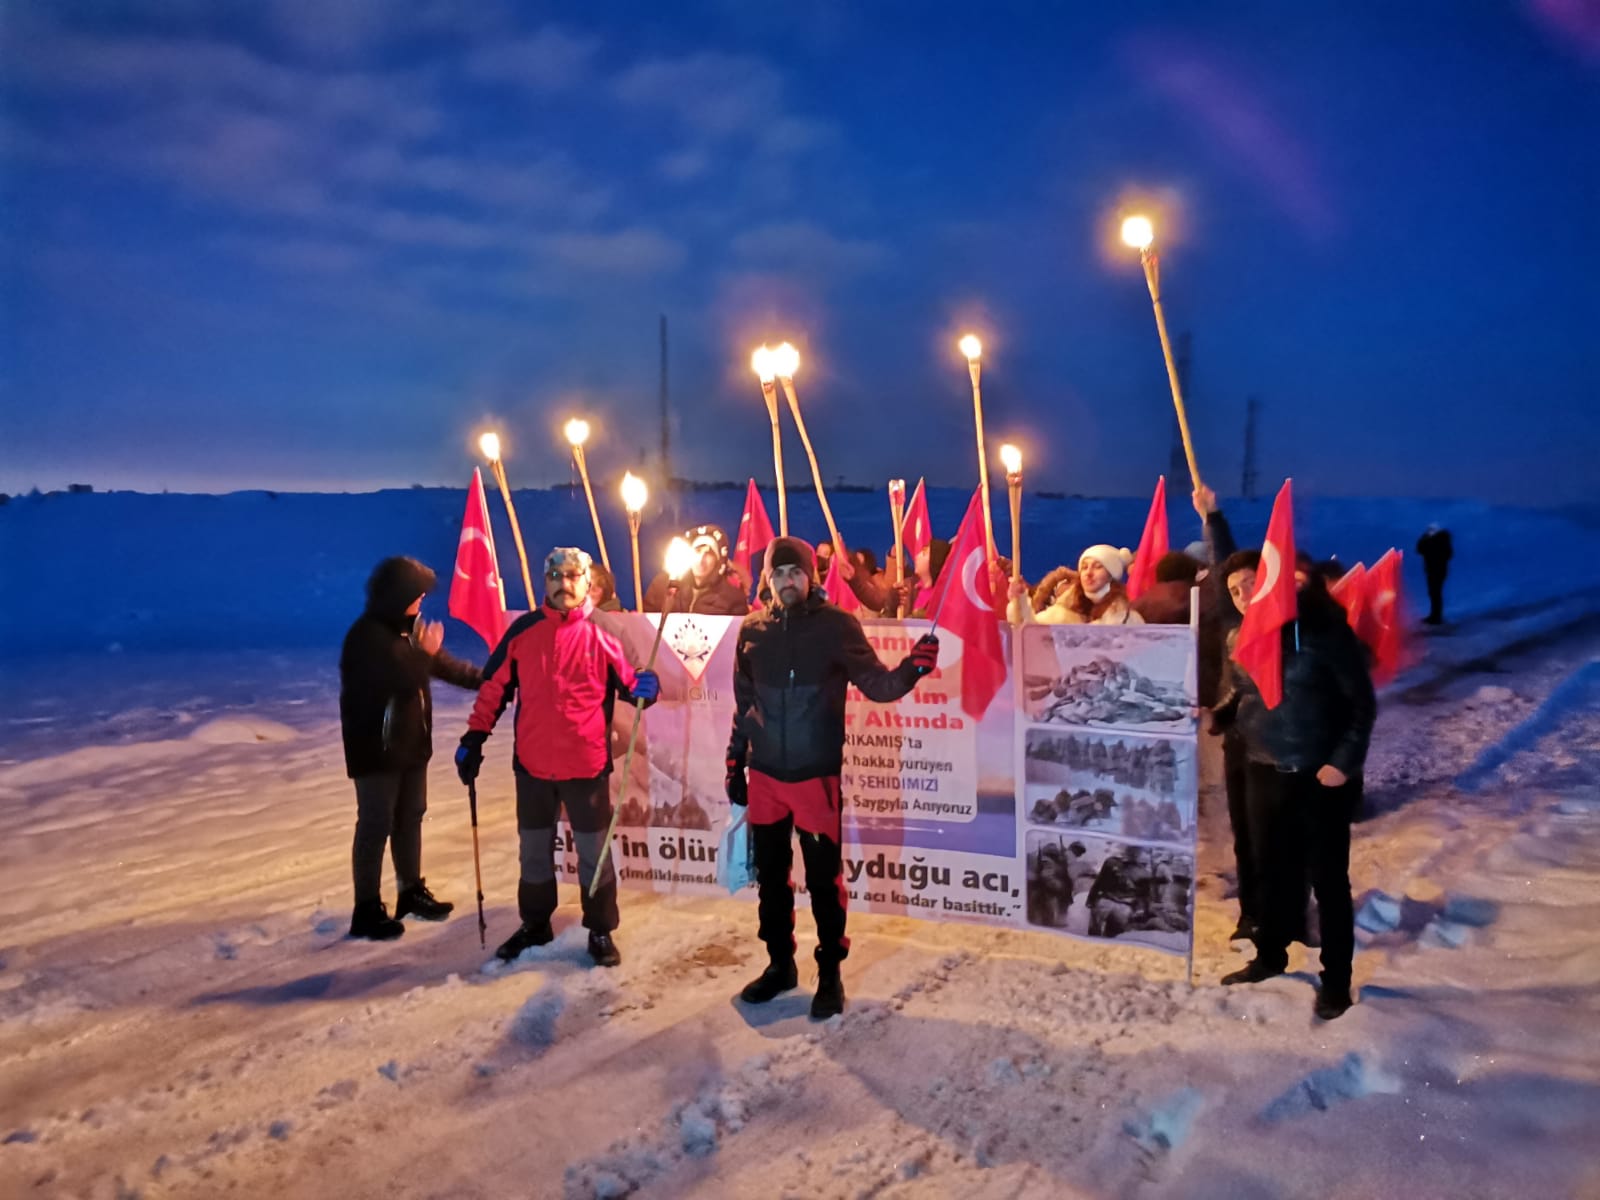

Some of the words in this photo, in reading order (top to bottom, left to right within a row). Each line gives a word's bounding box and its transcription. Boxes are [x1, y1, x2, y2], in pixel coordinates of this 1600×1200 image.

[865, 710, 964, 730] Altında
[853, 755, 895, 769] hakka
[853, 794, 909, 813] Saygıyla
[842, 853, 951, 890] yduğu
[962, 869, 1020, 898] acı,
[863, 891, 886, 903] acı
[891, 890, 938, 909] kadar
